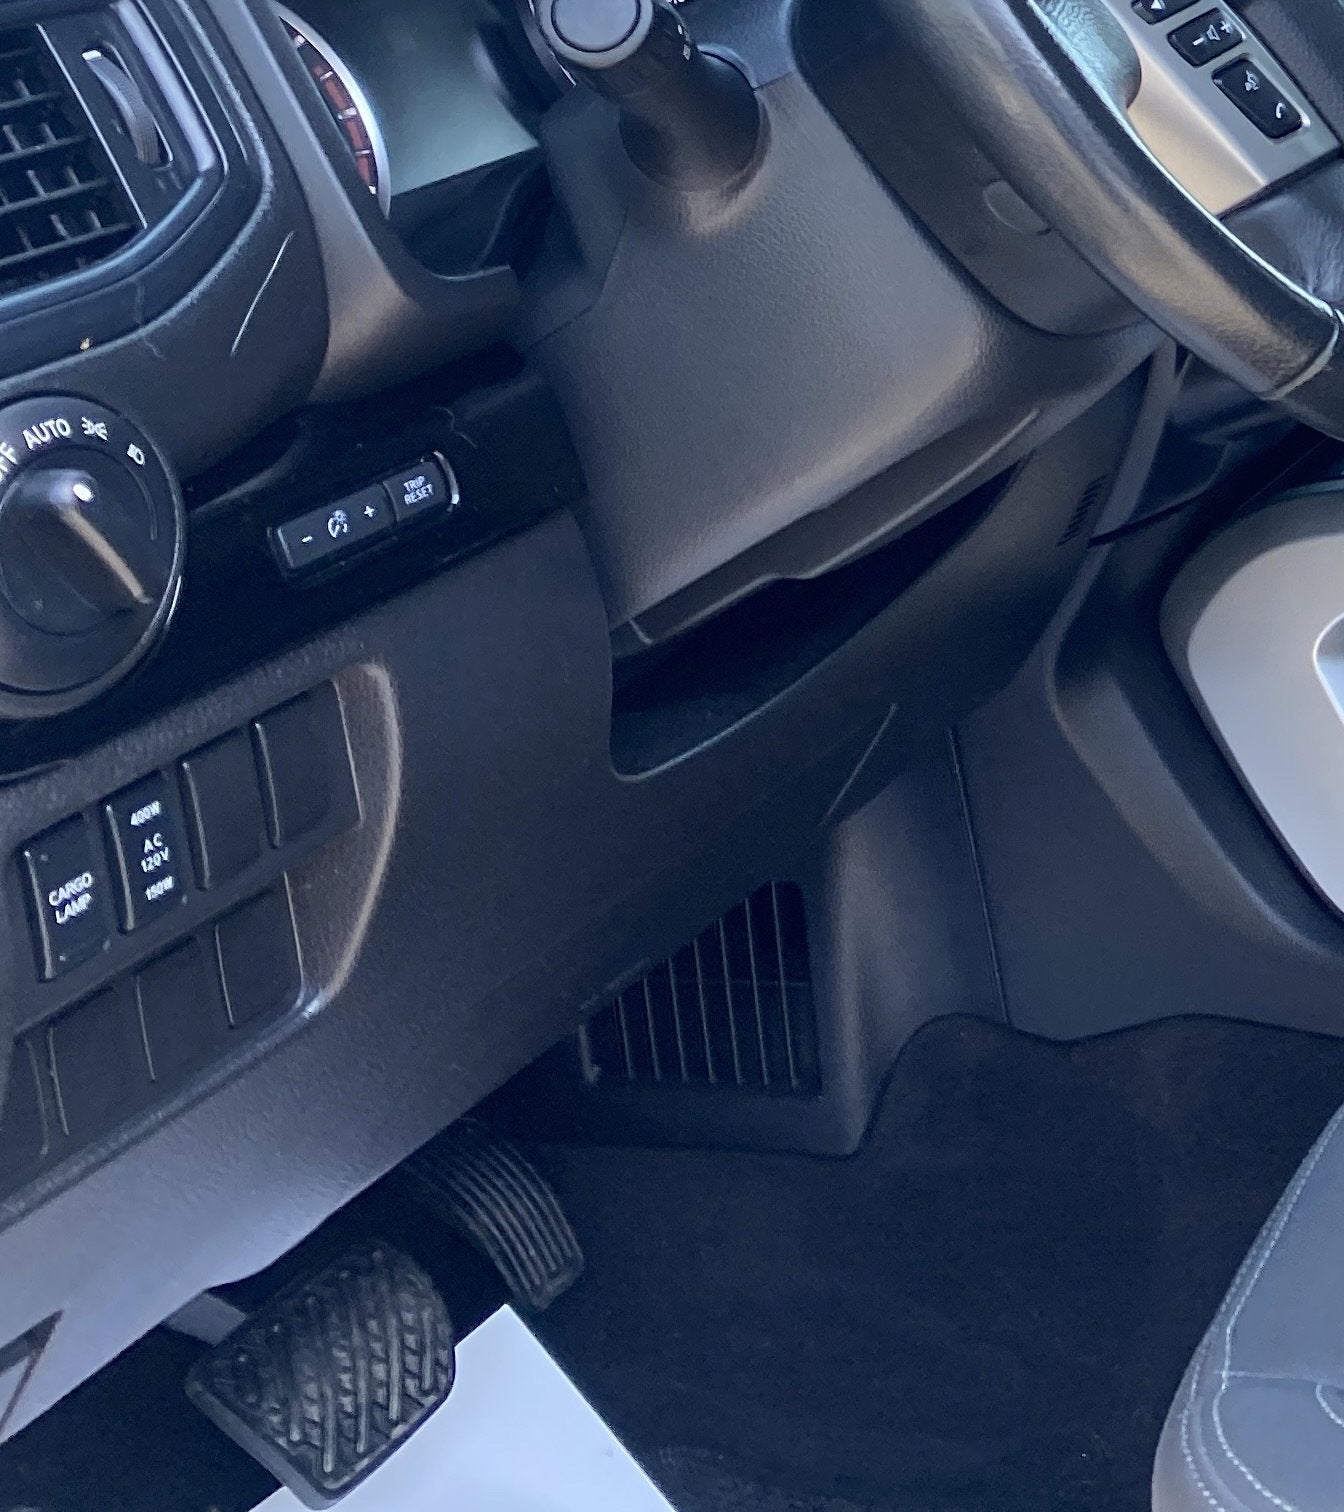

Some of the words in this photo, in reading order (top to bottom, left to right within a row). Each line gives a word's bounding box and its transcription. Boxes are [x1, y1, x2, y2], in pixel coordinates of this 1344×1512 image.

[22, 418, 71, 450] AUTO
[0, 441, 18, 482] FF
[403, 475, 425, 491] TRIP
[404, 483, 433, 505] RESET
[130, 800, 161, 826] 400W
[140, 846, 169, 873] 120V
[48, 871, 94, 906] CARGO
[55, 892, 93, 924] LAMP
